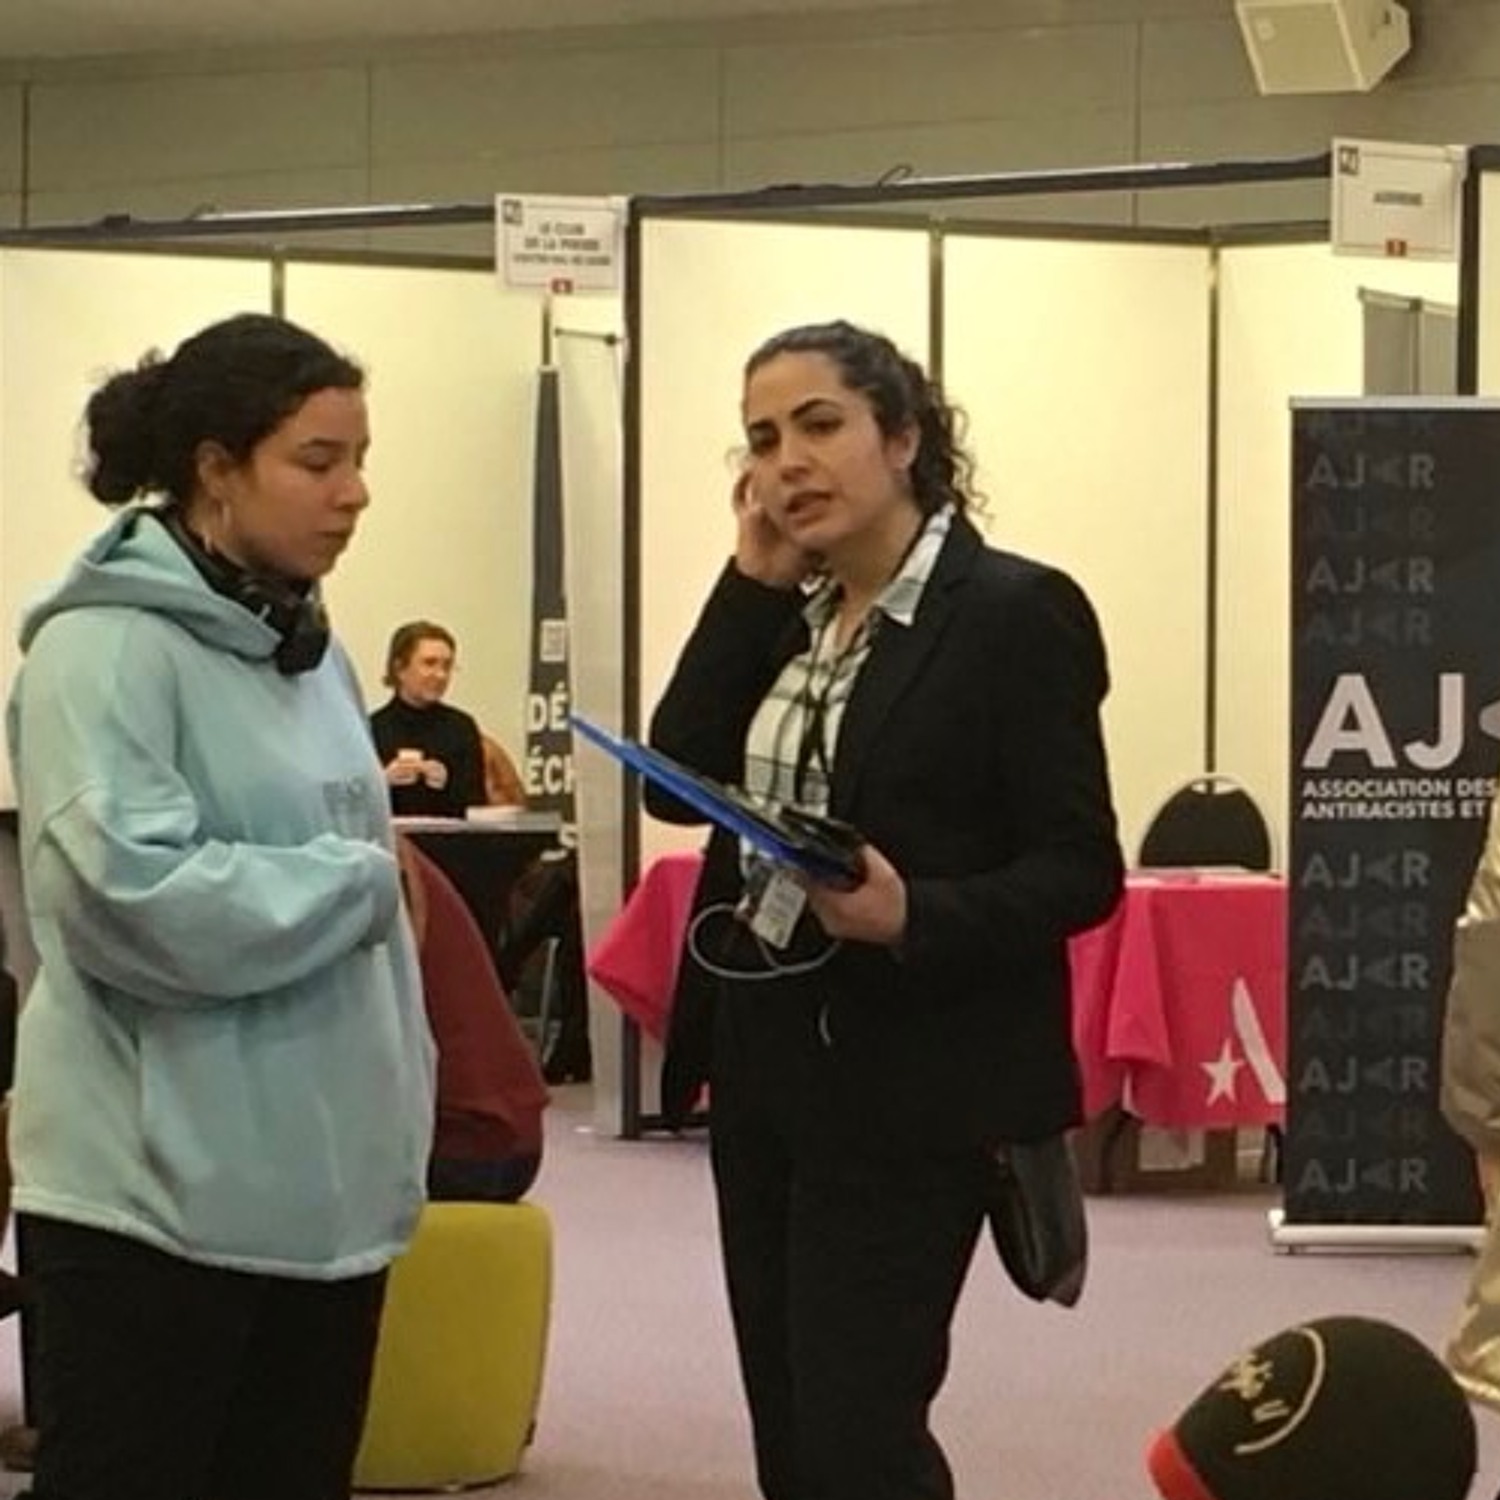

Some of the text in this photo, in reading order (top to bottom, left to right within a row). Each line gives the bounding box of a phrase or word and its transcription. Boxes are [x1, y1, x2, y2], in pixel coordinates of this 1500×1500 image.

[1303, 778, 1498, 798] ASSOCIATION DES
[1302, 801, 1486, 819] ANTIRACISTES ET
